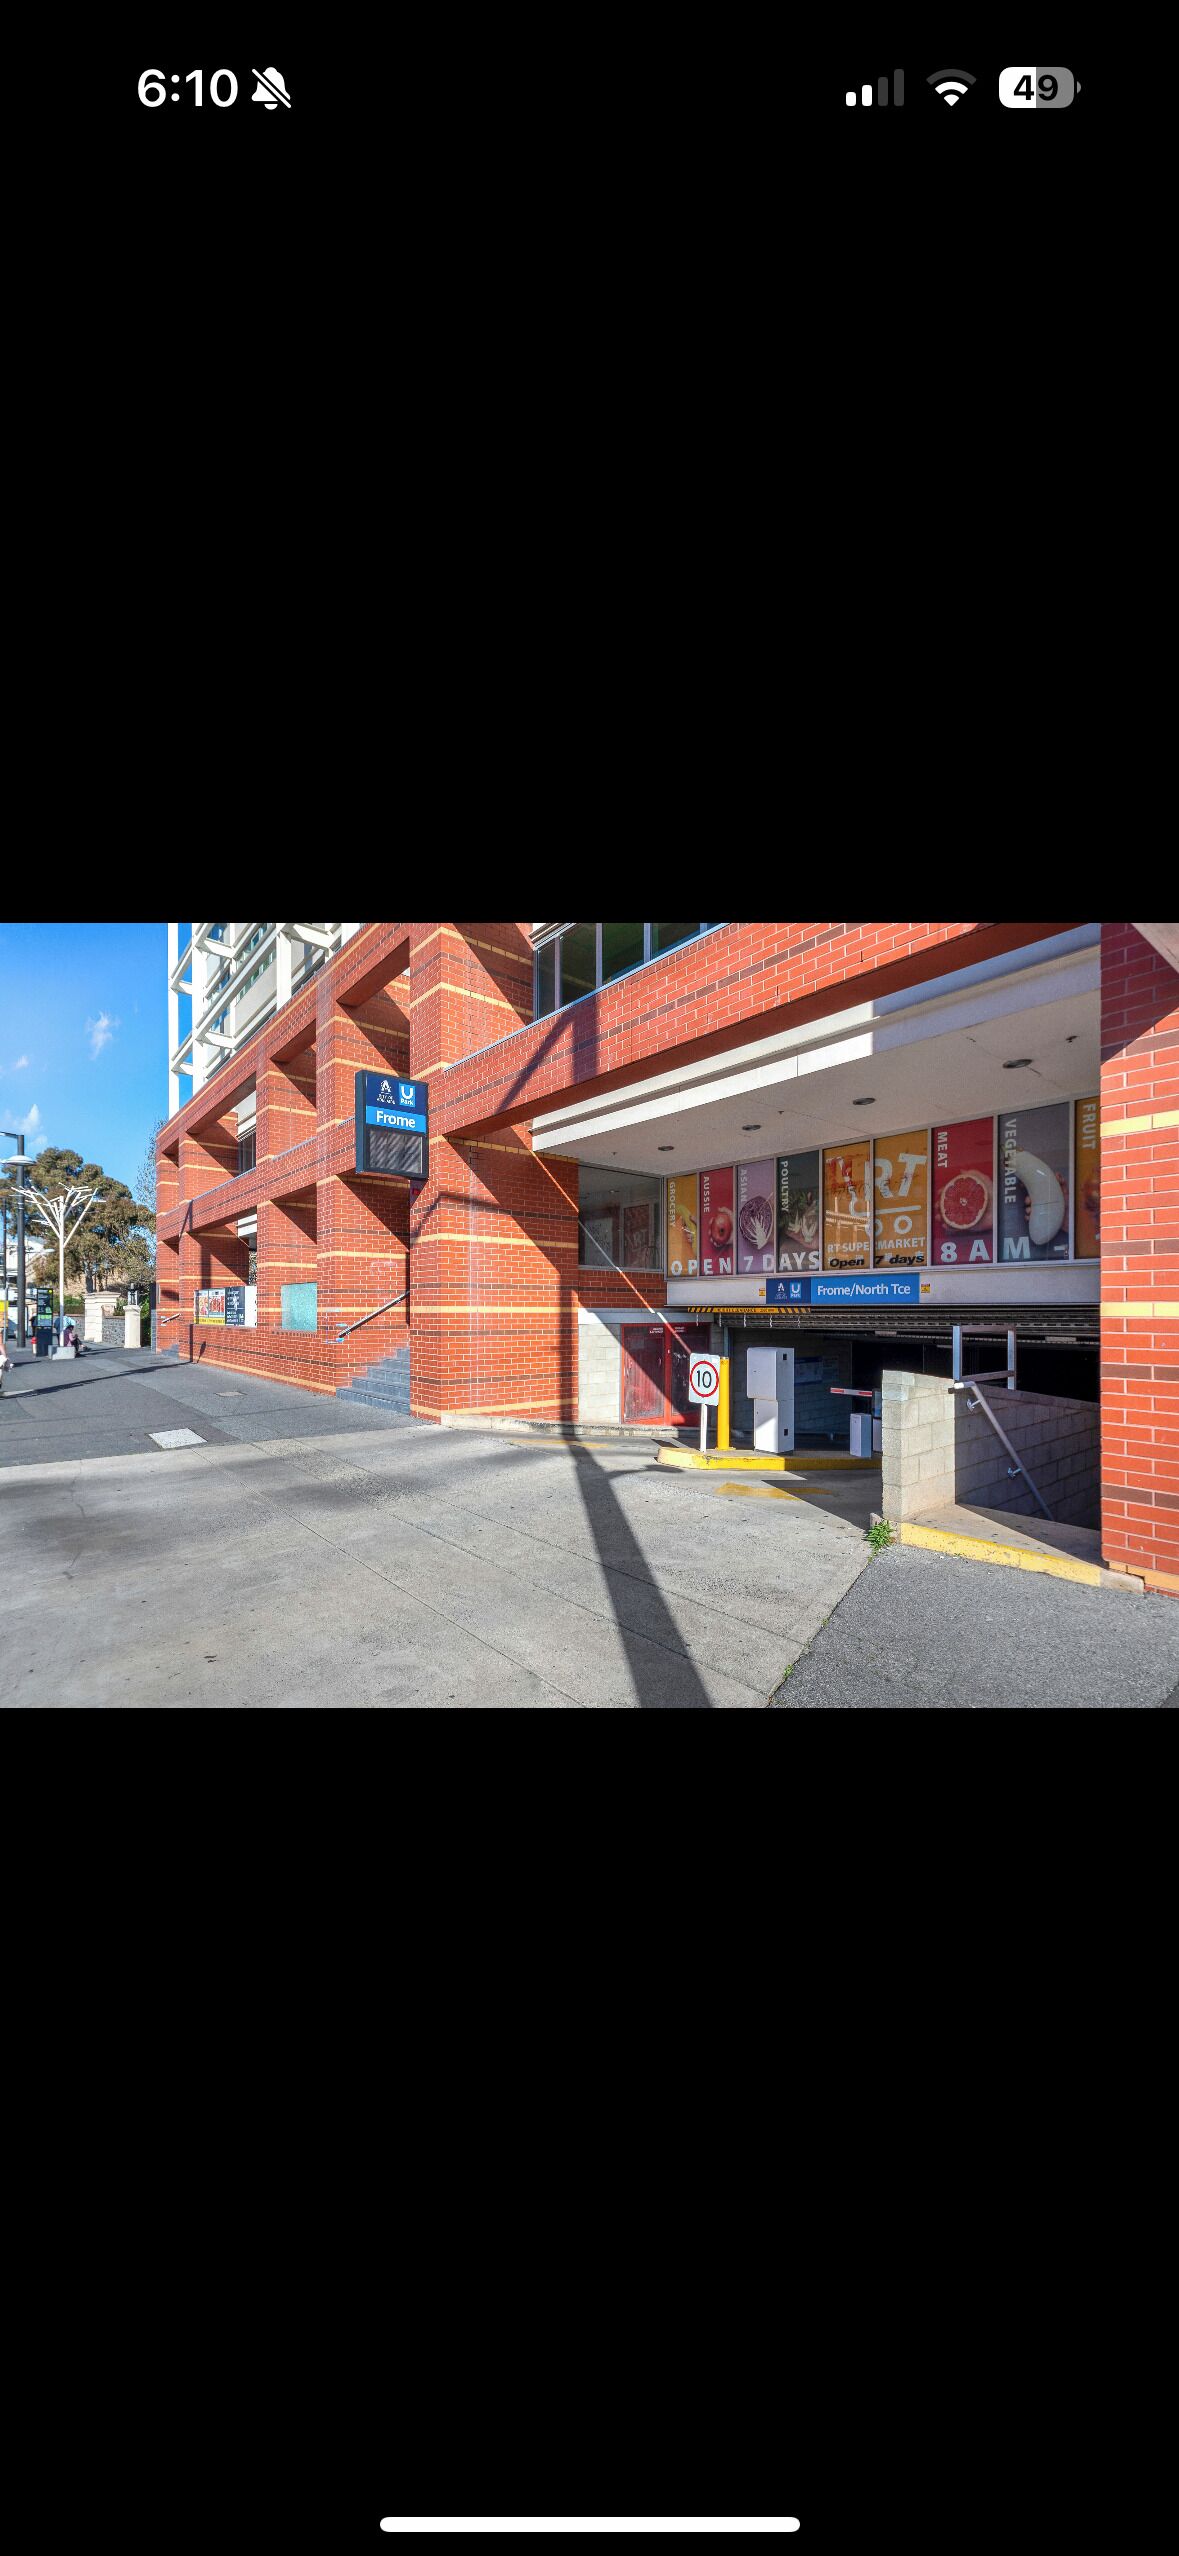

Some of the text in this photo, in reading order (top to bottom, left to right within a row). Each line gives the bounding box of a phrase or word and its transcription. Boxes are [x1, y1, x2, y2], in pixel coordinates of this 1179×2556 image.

[400, 1085, 414, 1099] U
[376, 1110, 416, 1128] Frome
[1082, 1103, 1096, 1150] FRUIT
[937, 1131, 948, 1168] MEAT
[1004, 1118, 1017, 1204] VEGETABLE
[740, 1168, 748, 1203] ASIAN
[780, 1160, 789, 1212] POULTRY
[671, 1257, 732, 1276] OPEN
[743, 1255, 754, 1272] 7
[762, 1250, 820, 1272] DAYS
[829, 1253, 925, 1269] Open 7 days
[817, 1282, 889, 1297] Frome/North
[890, 1283, 911, 1295] Tce
[696, 1370, 712, 1388] 10
